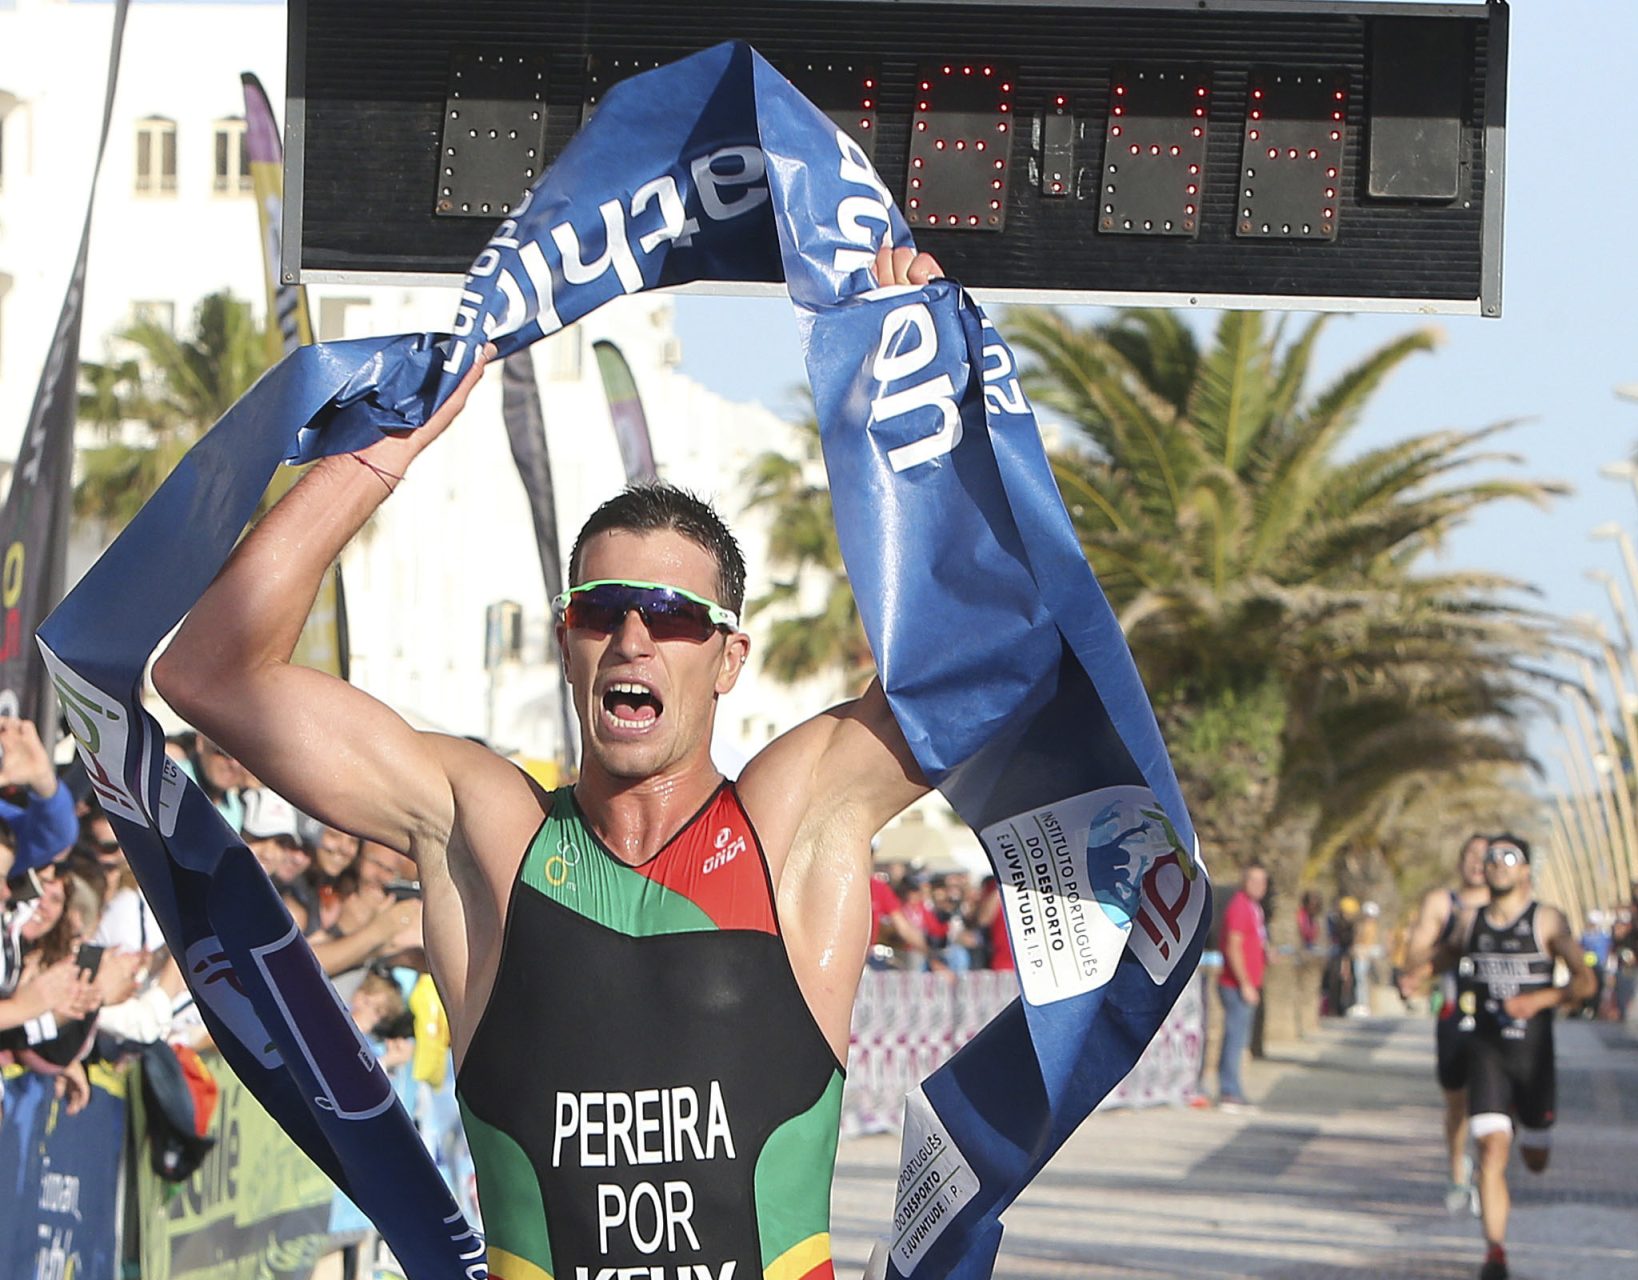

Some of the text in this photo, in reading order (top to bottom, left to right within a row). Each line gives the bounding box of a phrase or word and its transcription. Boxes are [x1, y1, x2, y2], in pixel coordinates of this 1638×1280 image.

[996, 833, 1007, 842] E
[1026, 836, 1065, 952] DO DESPORTO
[1039, 811, 1098, 977] INSTITUTO PORTUGUÊS
[552, 1079, 737, 1168] PEREIRA
[899, 1133, 943, 1187] PORTUGUÊS
[597, 1180, 701, 1254] POR
[904, 1170, 941, 1220] DESPORTO
